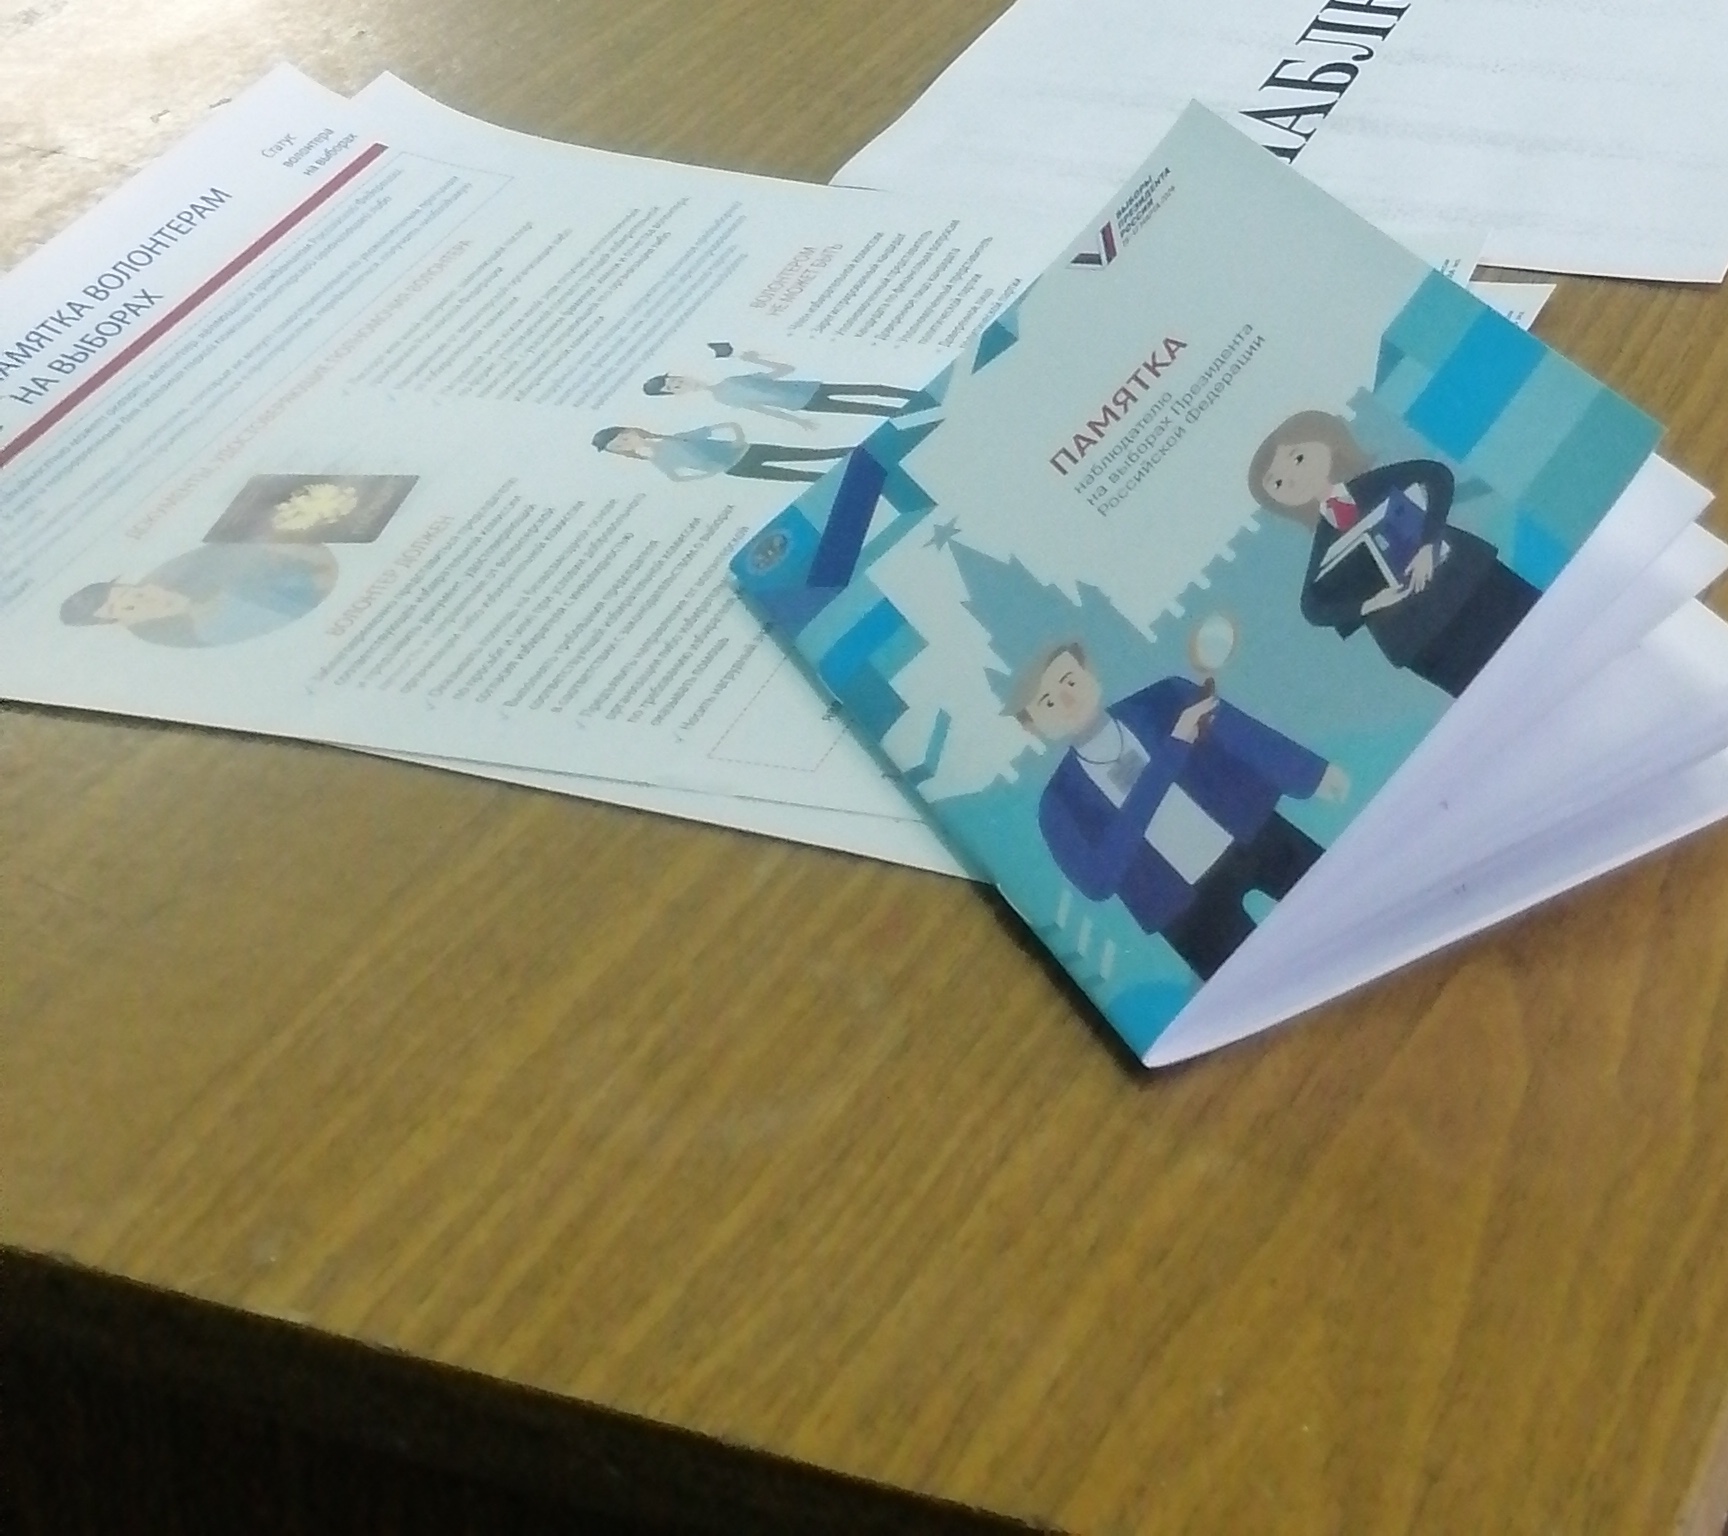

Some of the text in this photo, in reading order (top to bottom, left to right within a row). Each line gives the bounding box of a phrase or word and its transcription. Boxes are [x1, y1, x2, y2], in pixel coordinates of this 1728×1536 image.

[261, 131, 297, 159] Статус
[283, 127, 336, 169] волонтера
[303, 132, 358, 177] на выборах
[1116, 175, 1152, 219] ВЫБОРЫ
[0, 187, 233, 379] АМЯТКА ВОЛОНТЕРАМ
[747, 245, 818, 309] ВОЛОНТЕРОМ
[765, 242, 844, 316] НЕ МОЖЕТ БЫТЬ
[9, 287, 164, 406] НА ВЫБОРАХ
[1047, 331, 1189, 476] ПАМЯТКА
[1071, 389, 1175, 496] наблюдателю
[1084, 321, 1256, 507] на выборах Президента
[1095, 333, 1269, 518] Российской Федерации
[322, 514, 457, 636] ВОЛОНТЕР ДОЛЖЕН
